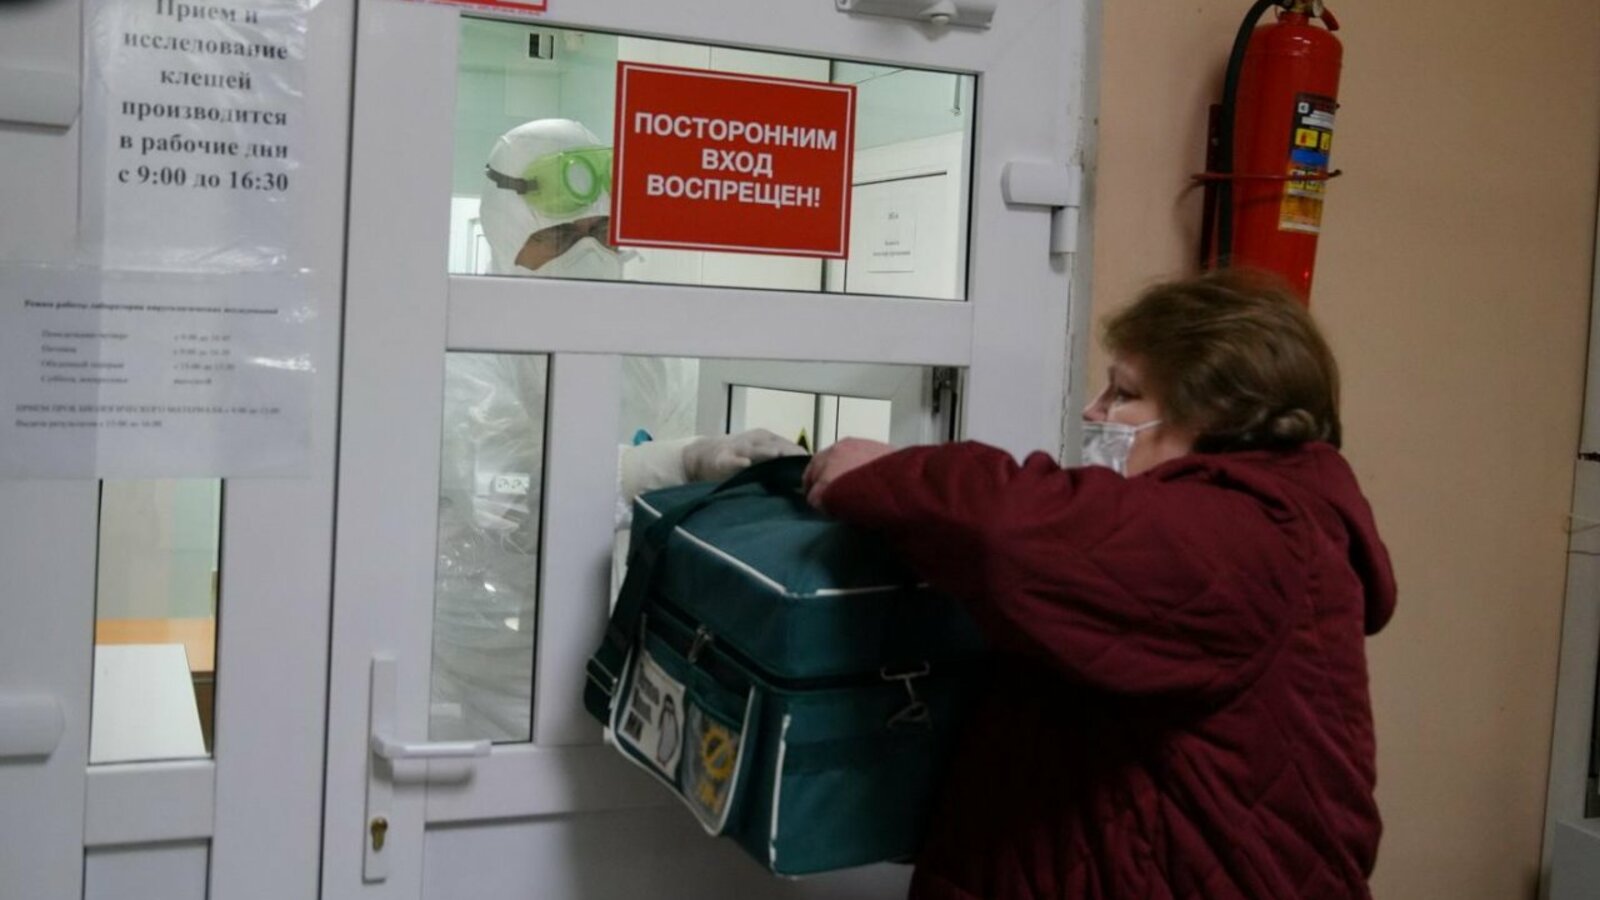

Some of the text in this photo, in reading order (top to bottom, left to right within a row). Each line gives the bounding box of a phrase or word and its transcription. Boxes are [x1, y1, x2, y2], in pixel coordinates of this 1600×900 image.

[156, 0, 259, 24] Прием и
[121, 101, 287, 126] производится
[634, 112, 838, 150] ПОСТОРОННИМ
[119, 134, 288, 159] в рабочие дни
[702, 149, 773, 178] ВХОД
[118, 165, 289, 192] с 9:00 до 16:30
[646, 174, 821, 208] ВОСПРЕЩЕН!
